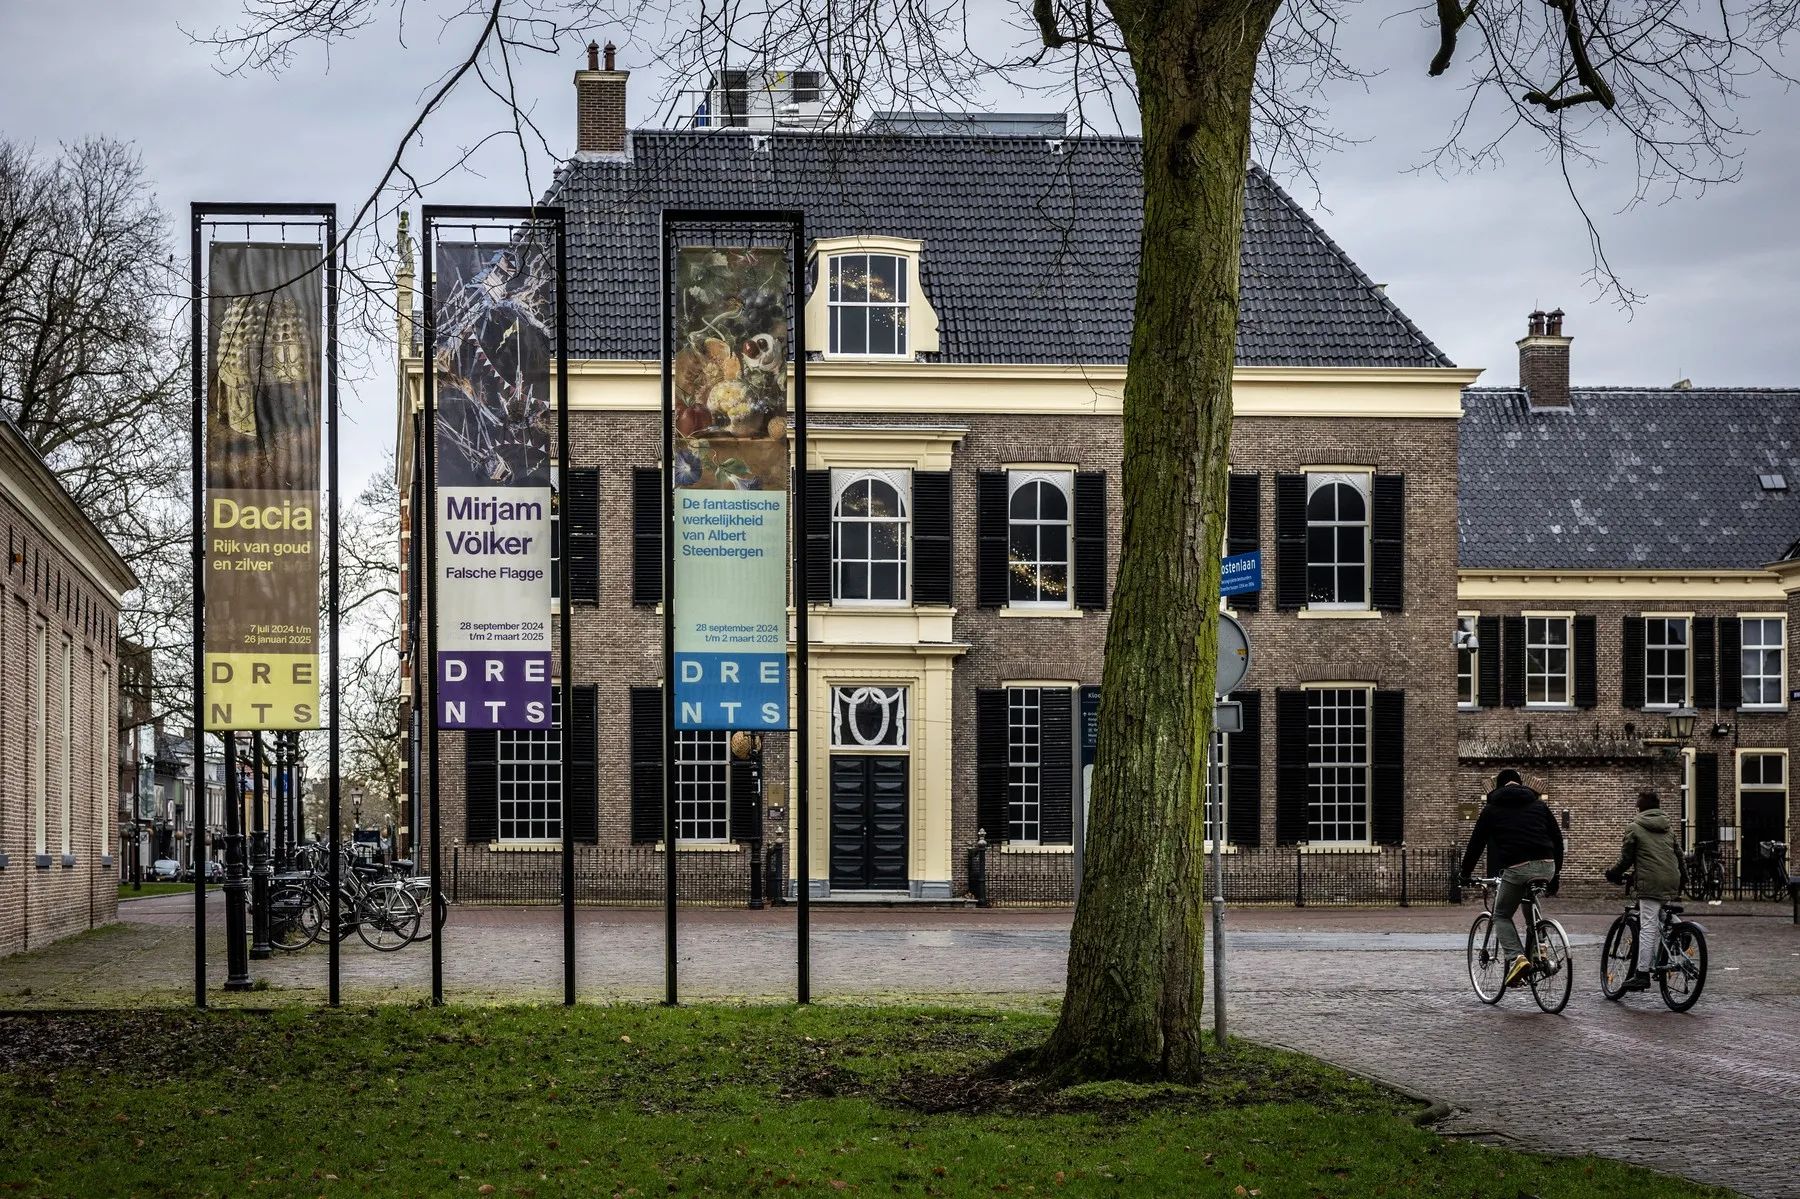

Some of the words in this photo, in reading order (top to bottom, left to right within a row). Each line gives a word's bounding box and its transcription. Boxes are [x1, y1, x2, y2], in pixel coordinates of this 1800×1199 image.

[447, 497, 541, 525] Mirjam
[683, 498, 700, 510] De
[703, 499, 780, 511] fantastische
[213, 498, 312, 530] Dacia
[682, 514, 763, 527] werkelijkheid
[682, 531, 704, 541] van
[708, 530, 746, 541] Albert
[213, 540, 240, 555] Rijk
[243, 543, 269, 553] van
[274, 541, 310, 556] goud
[446, 531, 532, 555] Völker
[682, 545, 763, 559] Steenbergen
[213, 561, 231, 570] en
[235, 559, 273, 571] zilver
[1221, 559, 1256, 575] ostenlaan
[446, 567, 496, 578] Falsche
[500, 567, 543, 581] Flagge
[256, 625, 270, 635] juli
[272, 625, 294, 633] 2024
[296, 625, 311, 633] t/m
[460, 622, 471, 630] 28
[473, 622, 520, 632] september
[696, 624, 707, 632] 28
[709, 624, 754, 634] september
[245, 635, 256, 643] 26
[257, 635, 287, 645] januari
[289, 636, 311, 644] 2025
[470, 633, 485, 641] t/m
[705, 635, 720, 643] t/m
[730, 635, 755, 643] maart
[757, 635, 778, 643] 2025
